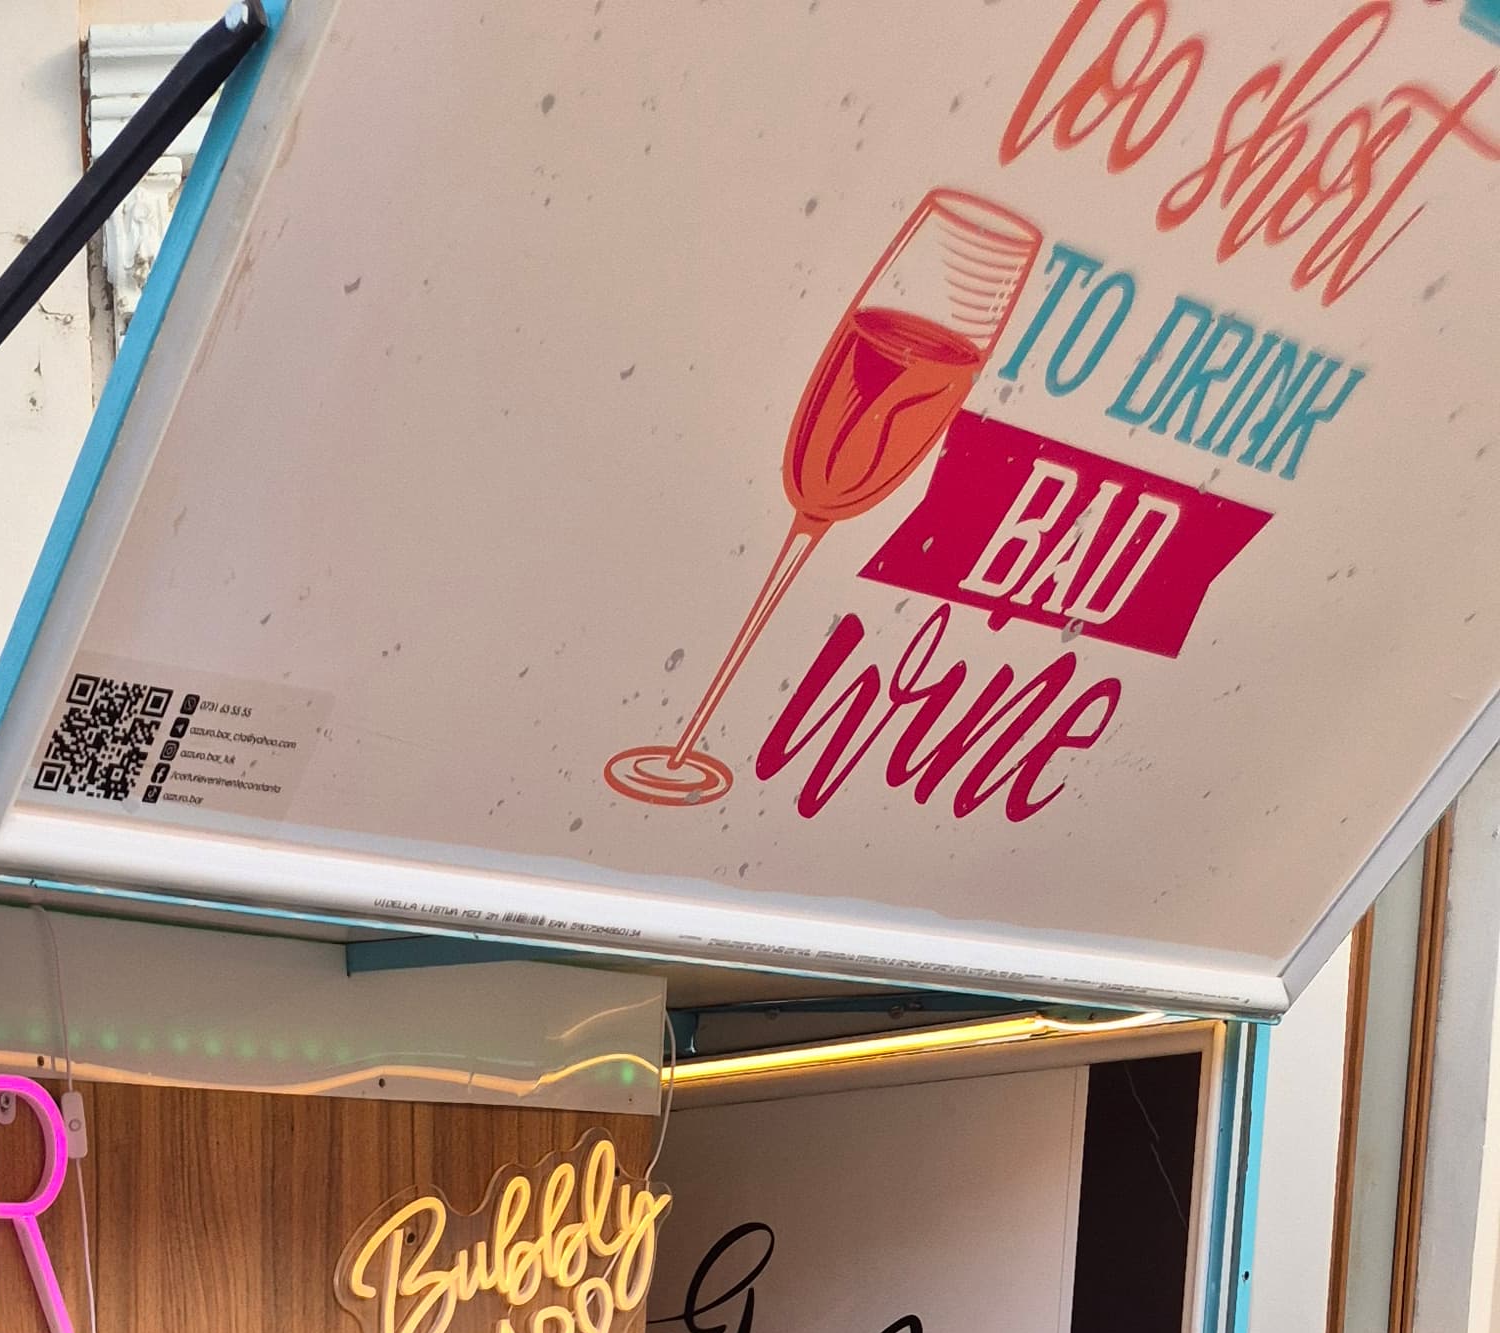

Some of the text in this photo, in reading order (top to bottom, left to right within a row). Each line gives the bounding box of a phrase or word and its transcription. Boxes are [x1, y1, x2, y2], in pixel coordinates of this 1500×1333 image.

[1156, 0, 1500, 307] short
[998, 241, 1367, 481] TO DRINK
[959, 459, 1180, 625] BAD
